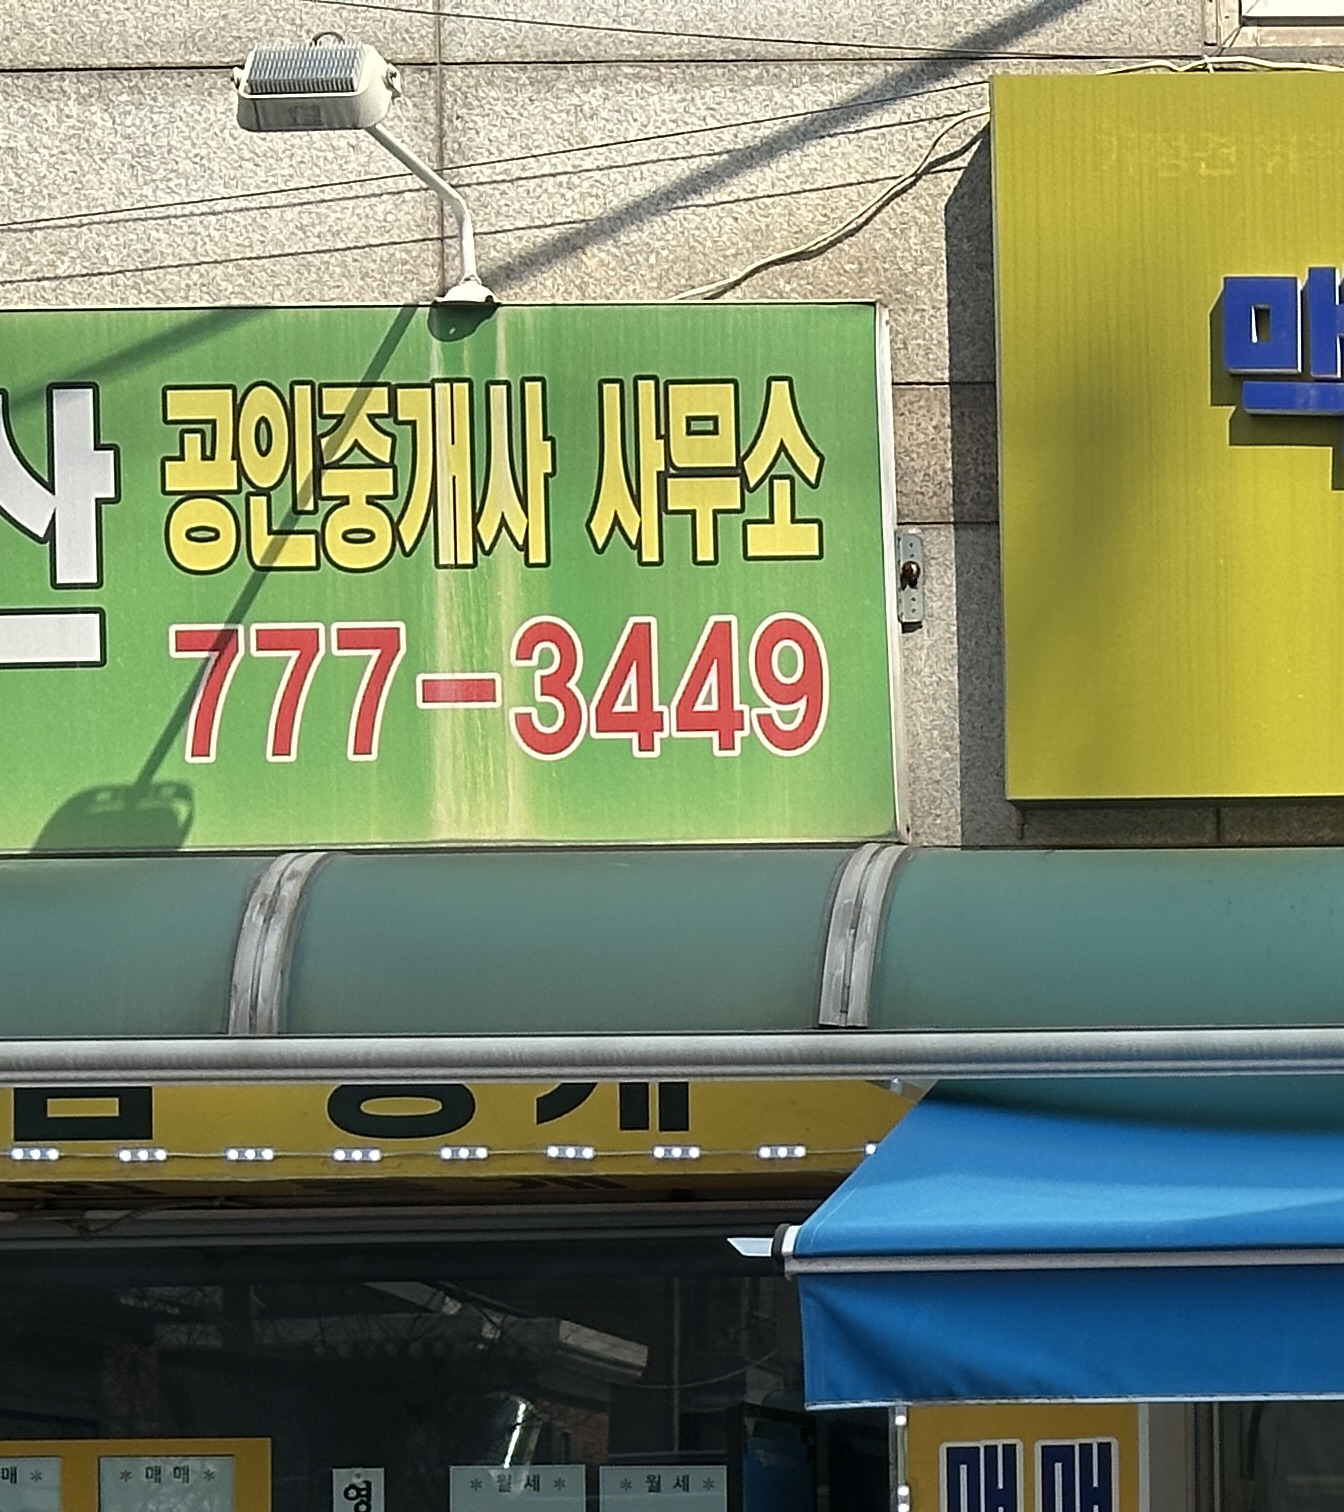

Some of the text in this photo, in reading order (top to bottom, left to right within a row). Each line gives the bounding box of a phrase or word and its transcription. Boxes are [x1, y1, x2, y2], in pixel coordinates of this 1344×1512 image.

[162, 377, 824, 573] 공인중개사 사무소
[170, 612, 830, 762] 777-3449
